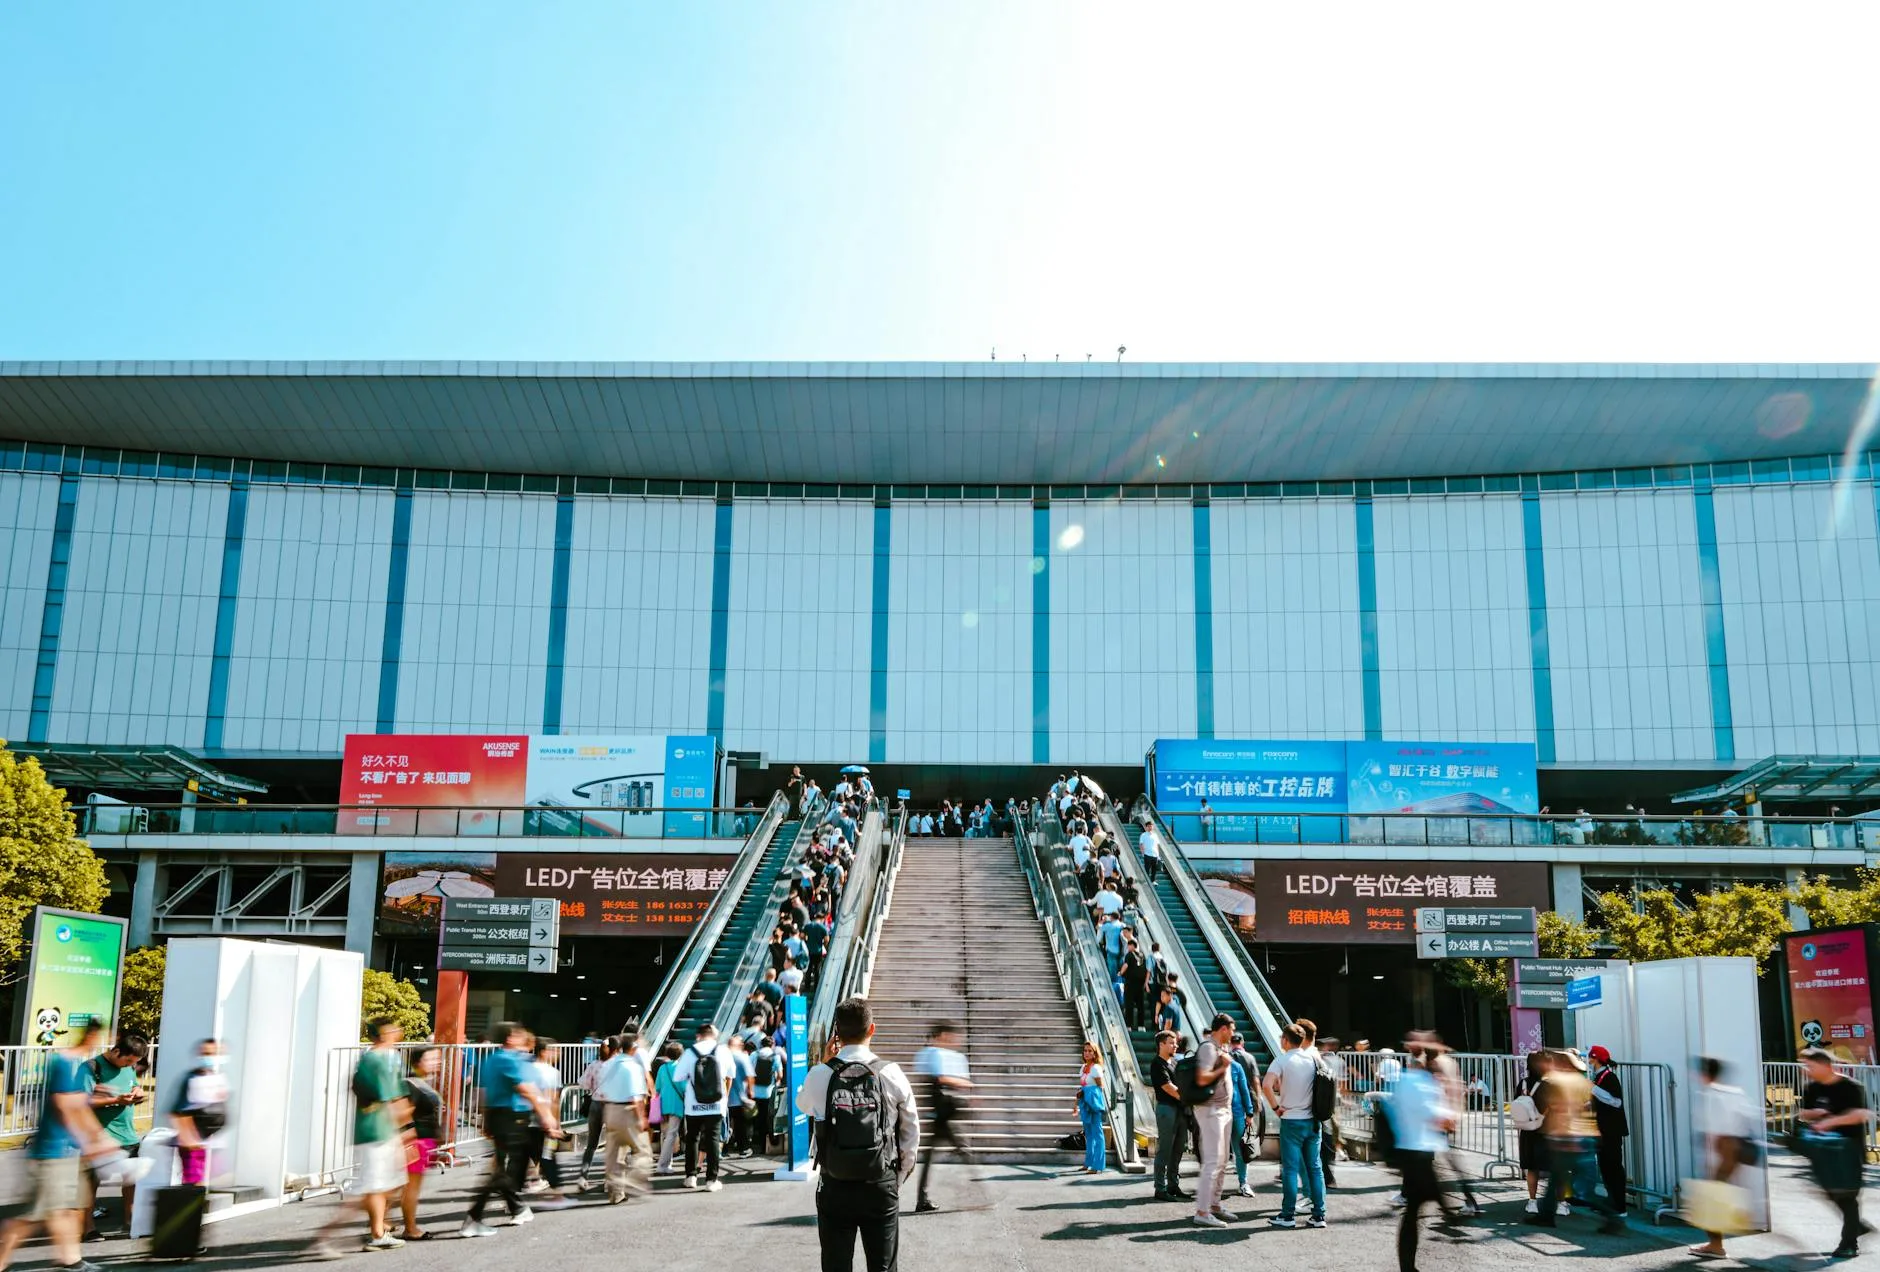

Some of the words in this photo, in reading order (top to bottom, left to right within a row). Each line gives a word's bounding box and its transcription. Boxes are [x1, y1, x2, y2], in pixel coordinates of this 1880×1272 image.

[482, 742, 520, 750] AKUSENSE
[361, 755, 409, 768] 好久不见
[360, 772, 420, 784] 不看广告了
[422, 772, 471, 784] 来见面聊
[525, 867, 729, 890] LED广告位全馆覆盖
[1286, 874, 1498, 898] LED广告位全馆覆盖
[489, 904, 531, 916] 西登录厅
[602, 900, 640, 910] 张先生
[646, 901, 665, 910] 186
[668, 901, 694, 910] 1633
[601, 914, 638, 923] 艾女士
[1288, 909, 1350, 926] 招商热线
[1366, 908, 1404, 917] 张先生
[1367, 920, 1405, 930] 艾女士
[1446, 914, 1488, 926] 西登录厅
[488, 928, 529, 940] 公交枢纽
[1448, 940, 1480, 951] 办公楼
[1482, 941, 1492, 951] A
[485, 953, 527, 965] 洲际酒店
